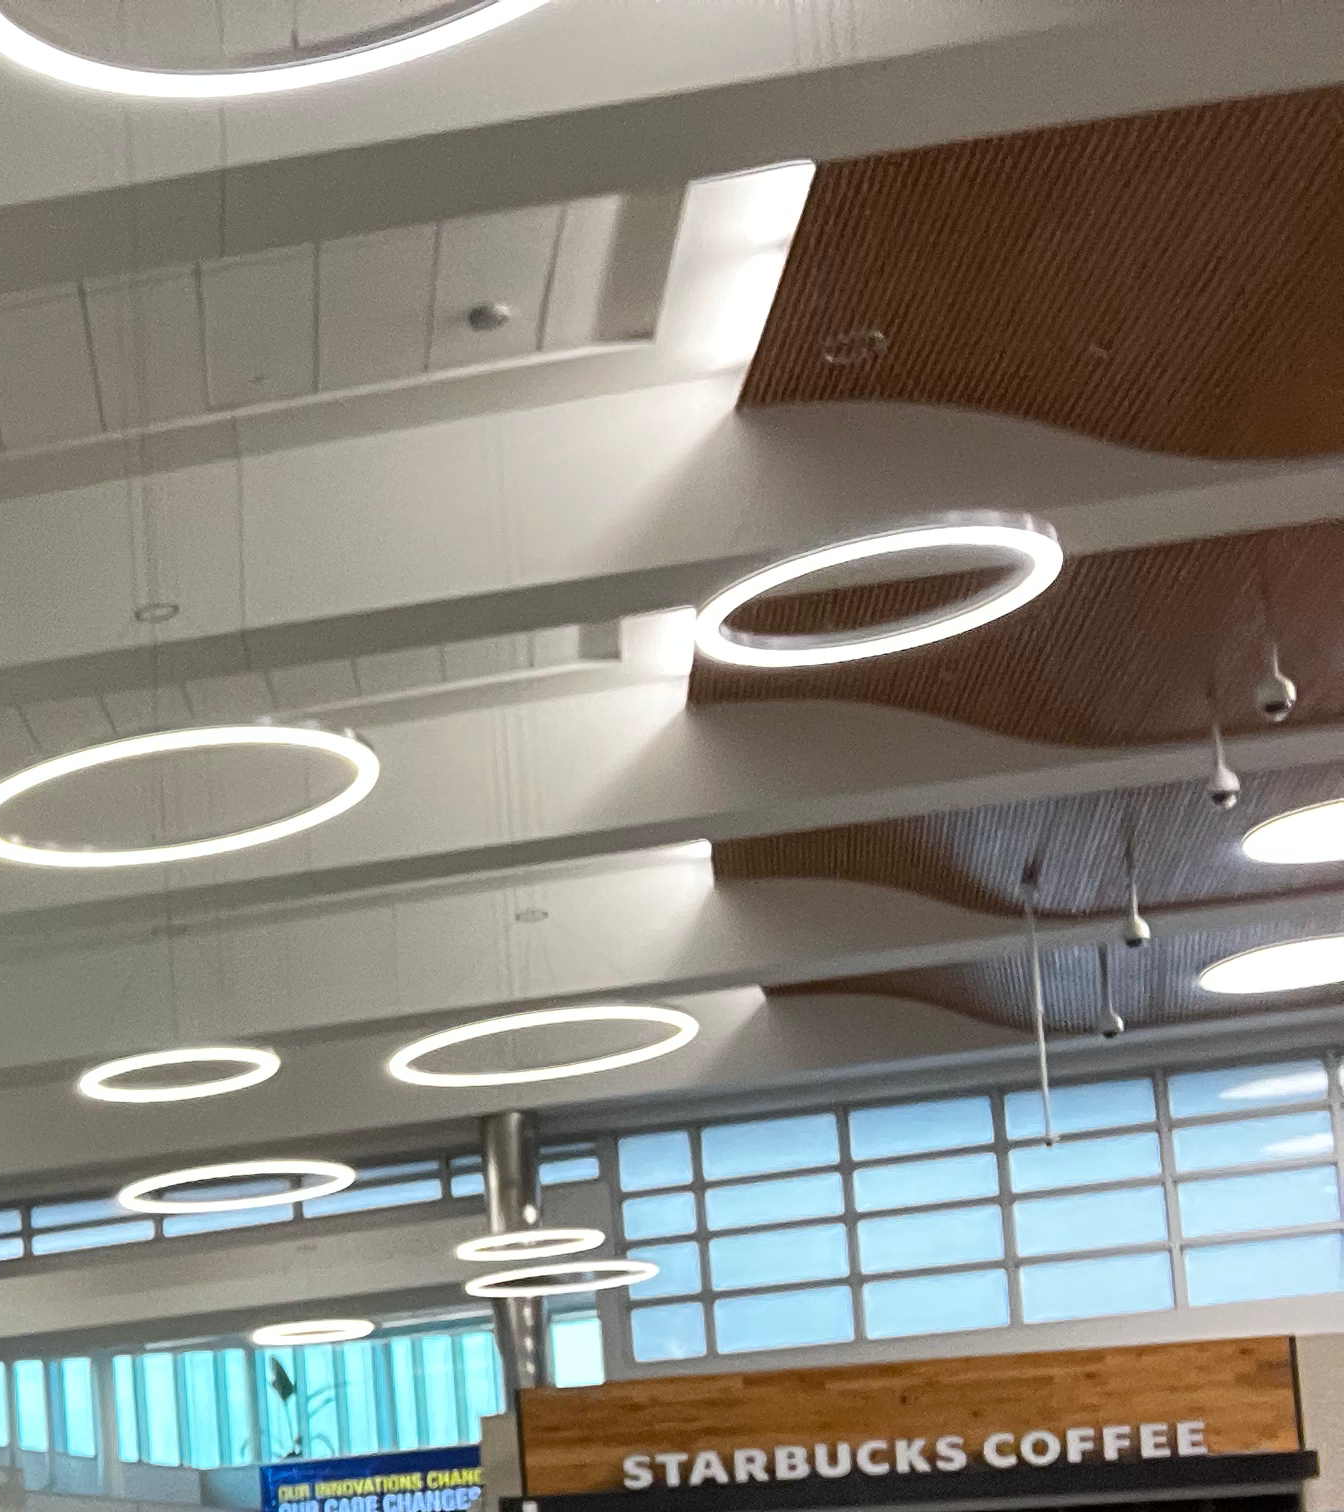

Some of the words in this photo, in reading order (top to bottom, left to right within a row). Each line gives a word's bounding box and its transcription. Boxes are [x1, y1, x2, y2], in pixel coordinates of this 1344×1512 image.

[622, 1436, 967, 1491] STARBUCKS
[983, 1420, 1209, 1469] COFFEE
[278, 1483, 310, 1503] OUR
[315, 1472, 423, 1499] INNOVATIONS
